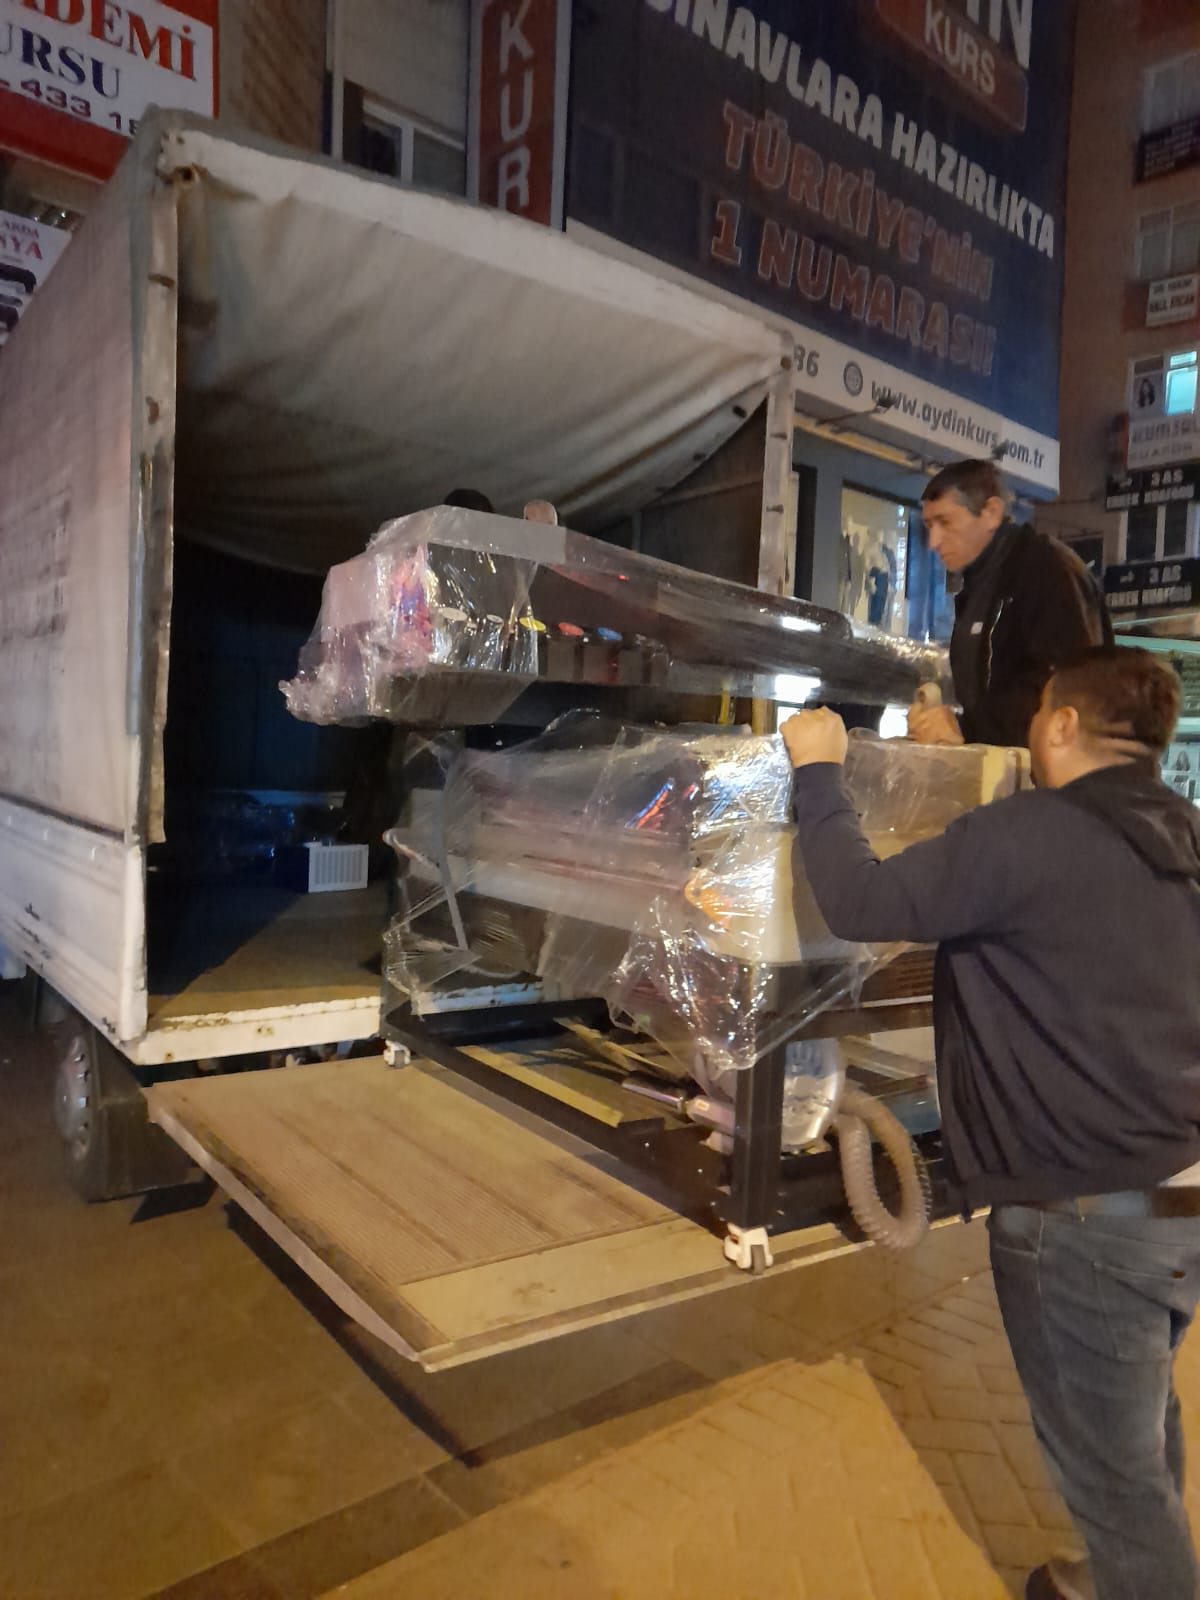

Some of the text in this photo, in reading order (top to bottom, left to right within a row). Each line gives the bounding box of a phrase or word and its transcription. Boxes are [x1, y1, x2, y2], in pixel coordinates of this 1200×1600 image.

[925, 0, 996, 96] KURS
[20, 79, 92, 117] 433
[646, 0, 1055, 259] INAVLARA HAZIRLIKTA
[711, 199, 742, 266] 1
